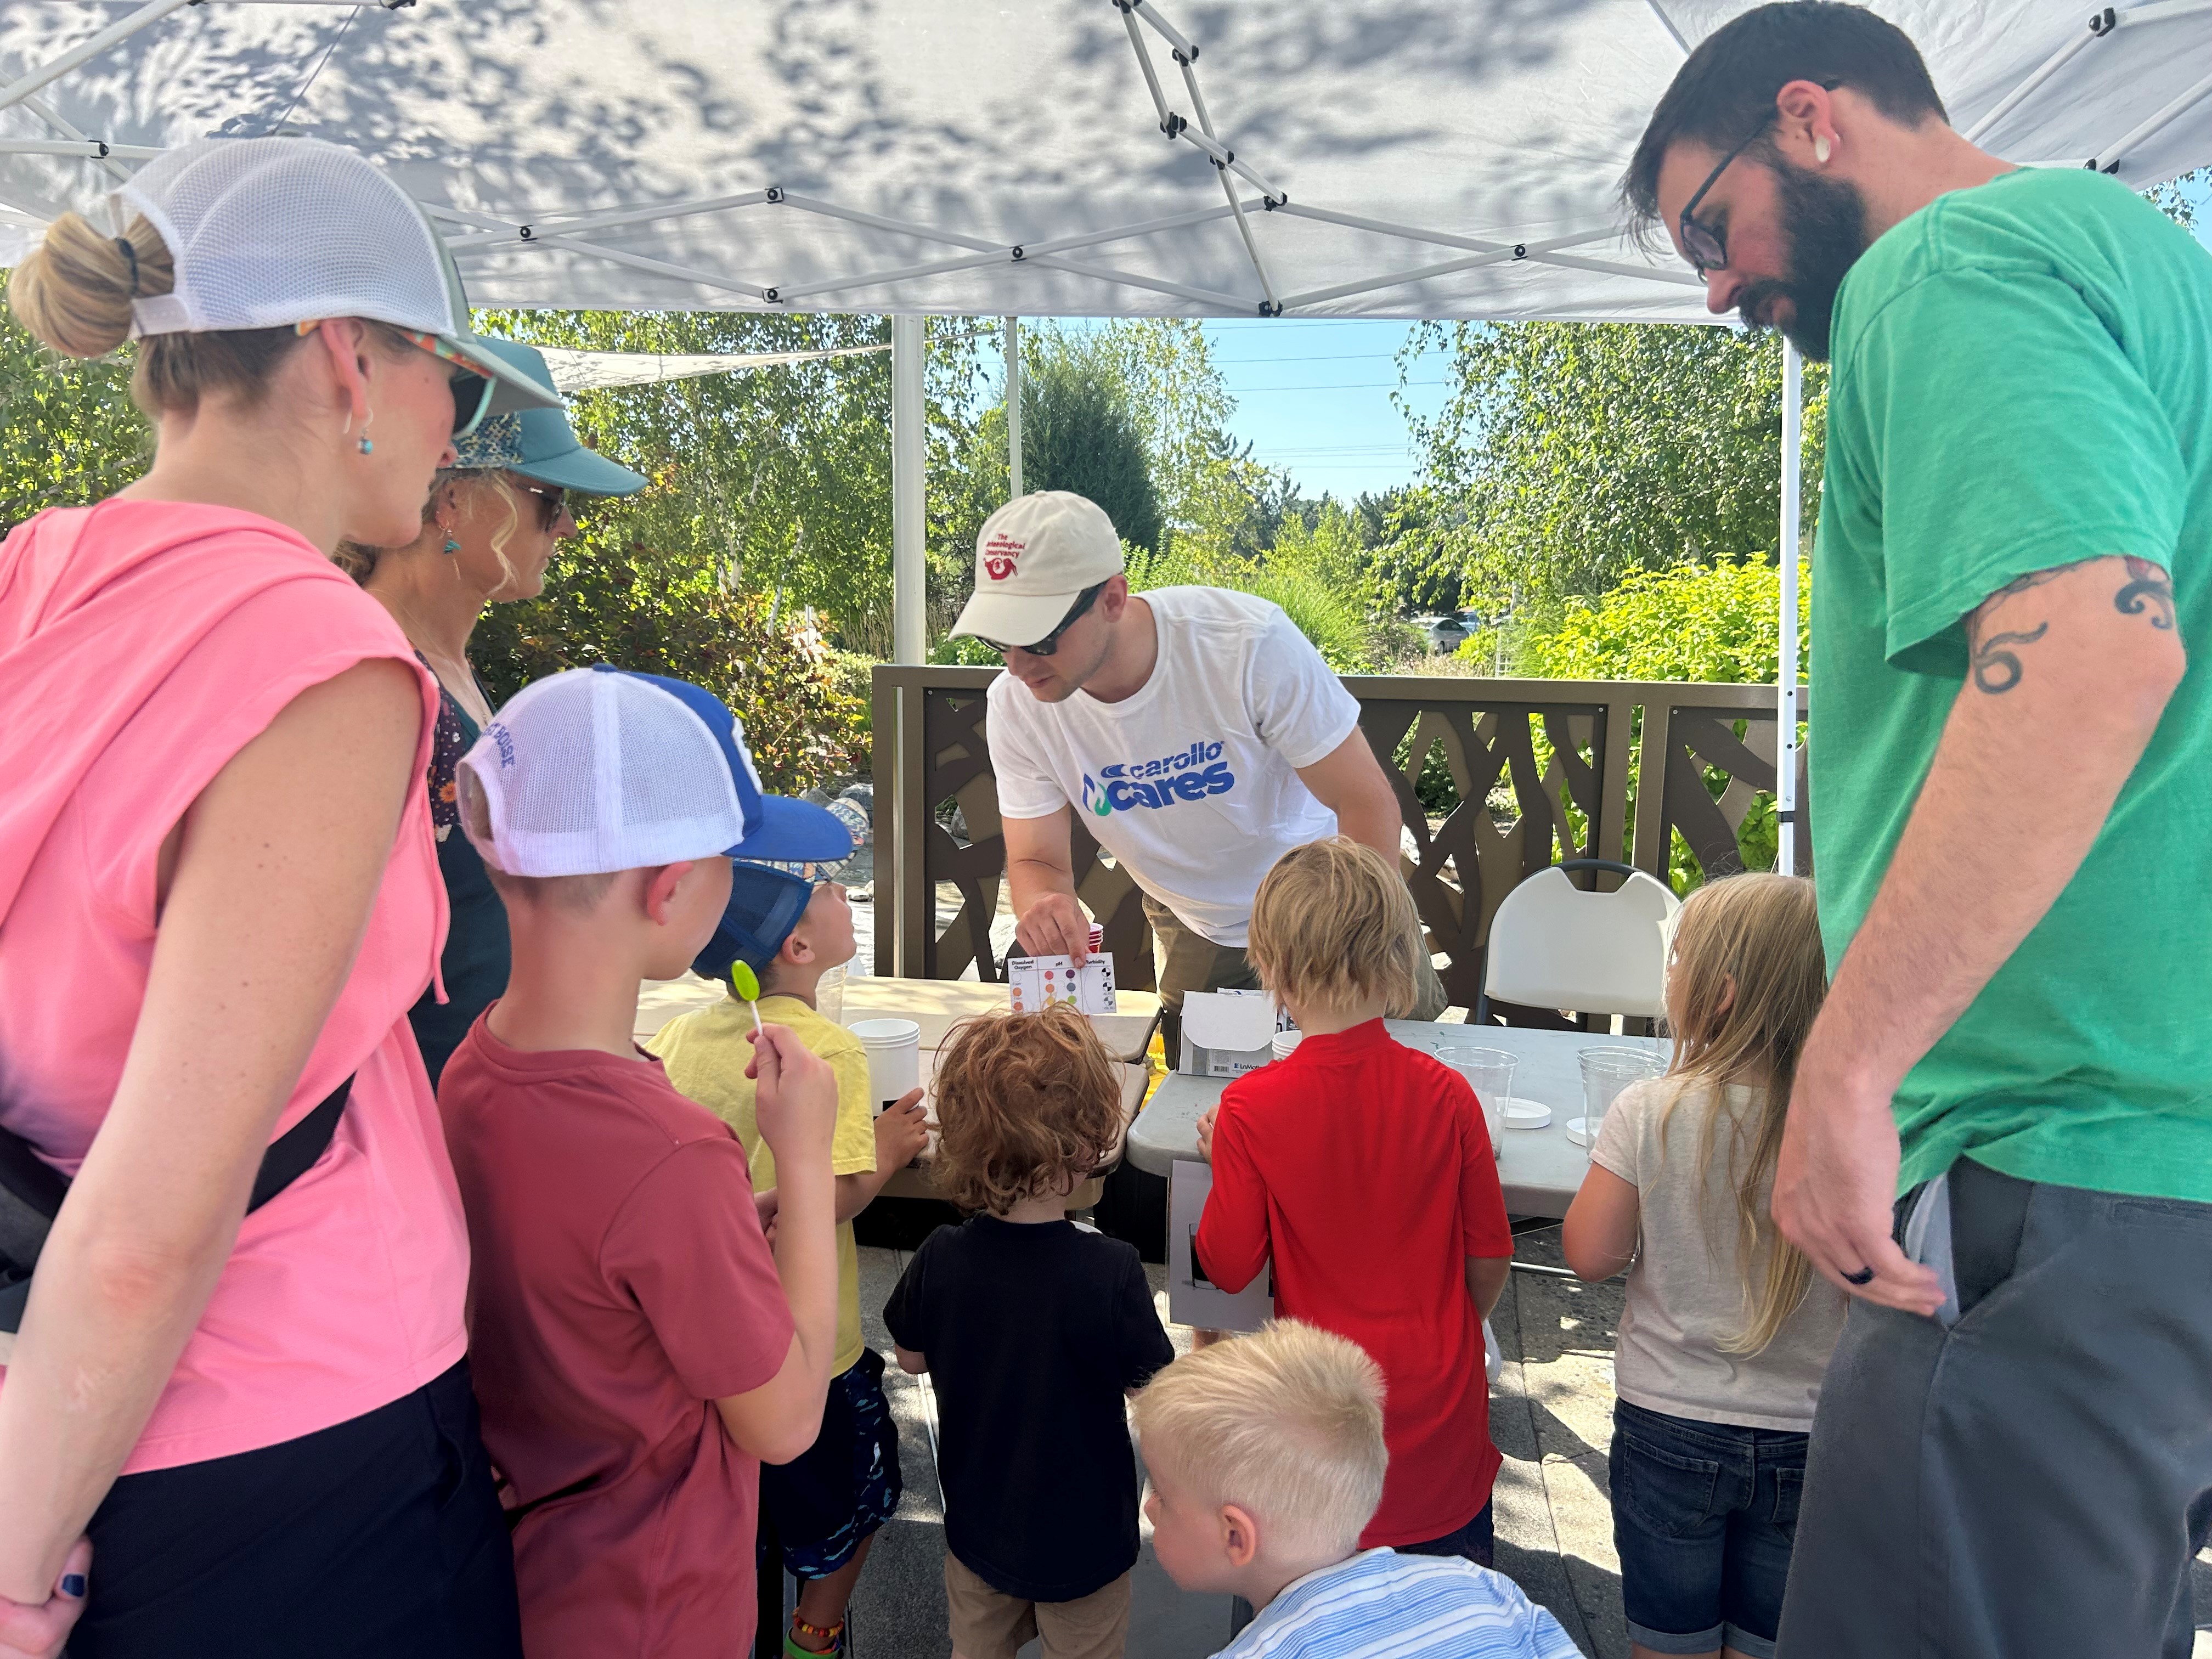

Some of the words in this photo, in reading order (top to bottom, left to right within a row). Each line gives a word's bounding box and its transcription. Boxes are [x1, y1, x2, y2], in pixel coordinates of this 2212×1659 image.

[493, 726, 515, 768] BOISE
[1130, 741, 1222, 779] carollo
[1107, 761, 1235, 811] cares
